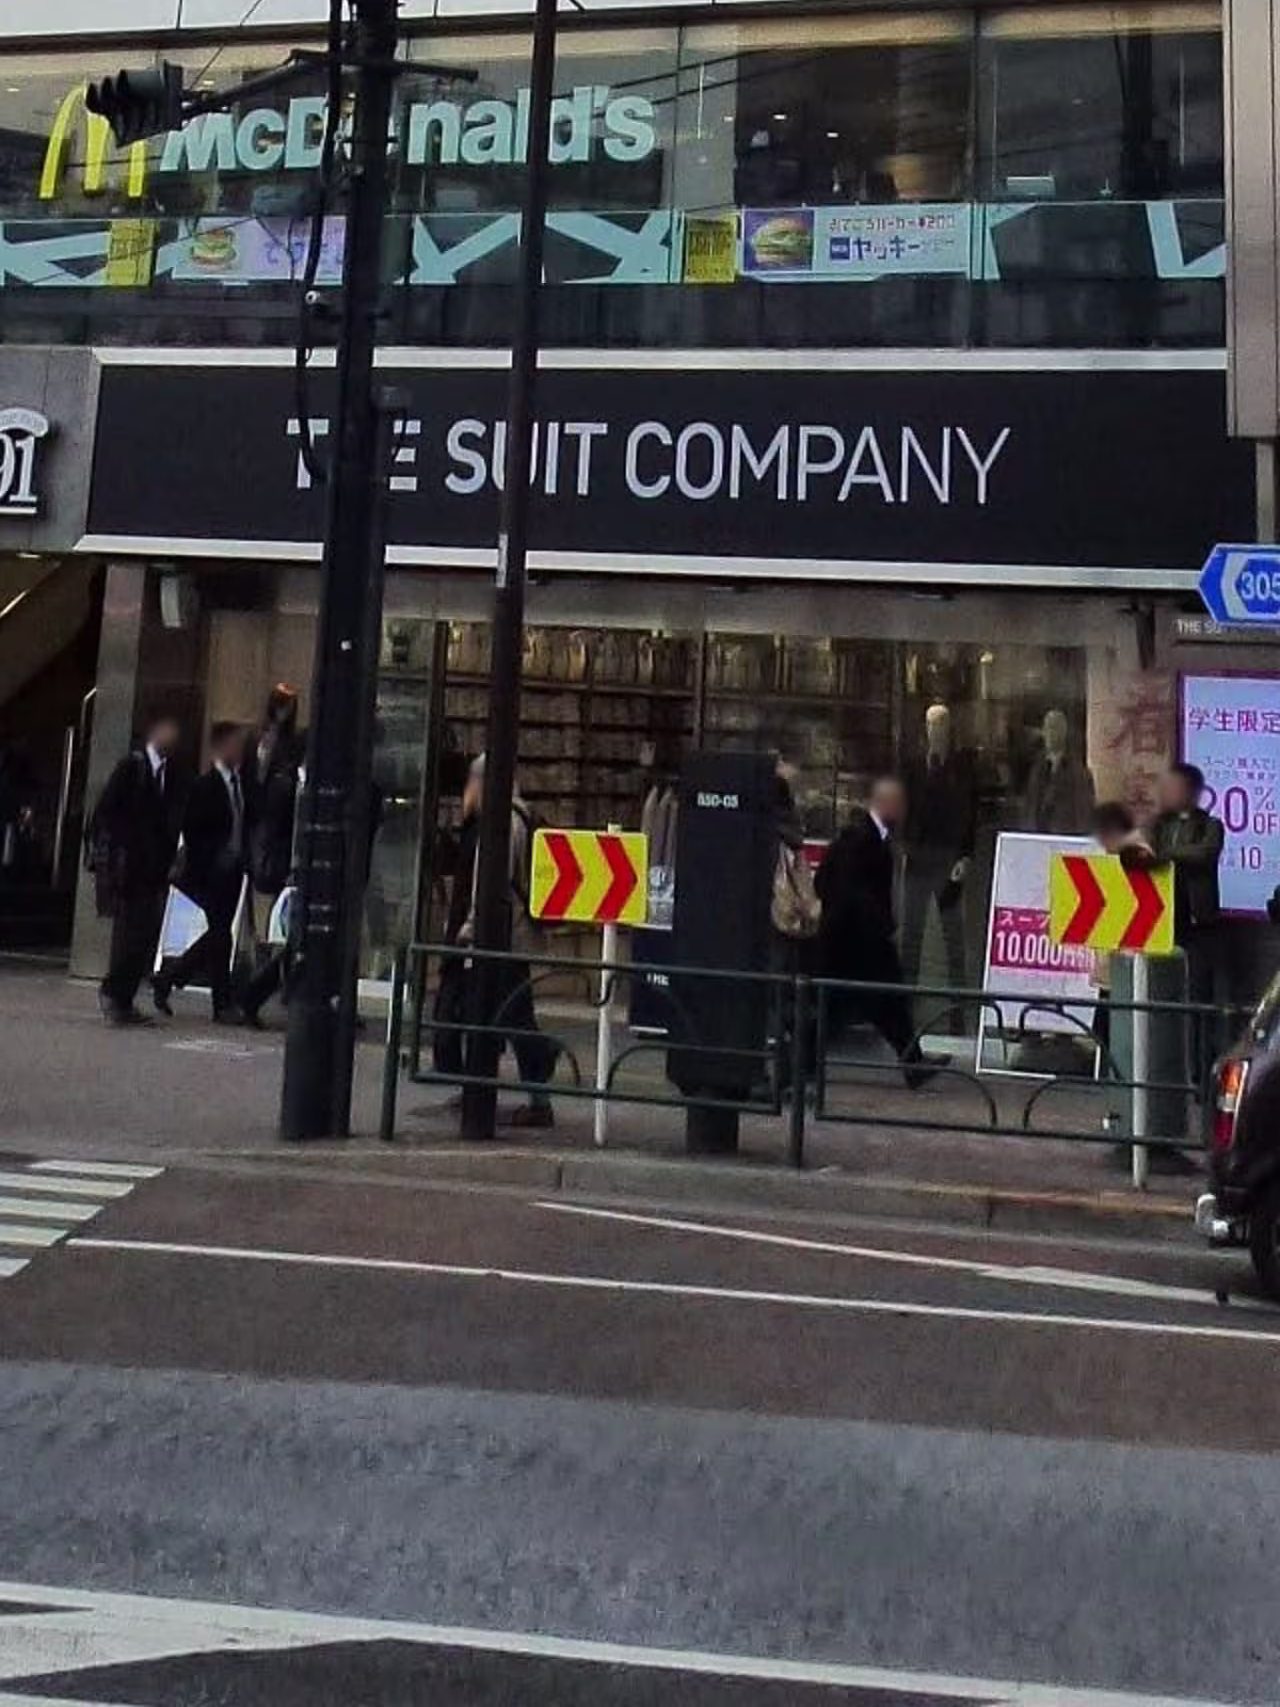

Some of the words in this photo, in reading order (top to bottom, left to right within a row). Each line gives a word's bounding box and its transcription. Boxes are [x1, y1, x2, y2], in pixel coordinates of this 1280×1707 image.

[160, 85, 656, 172] McDnald's
[287, 418, 421, 490] TE
[444, 418, 609, 496] SUIT
[625, 422, 1012, 505] COMPANY
